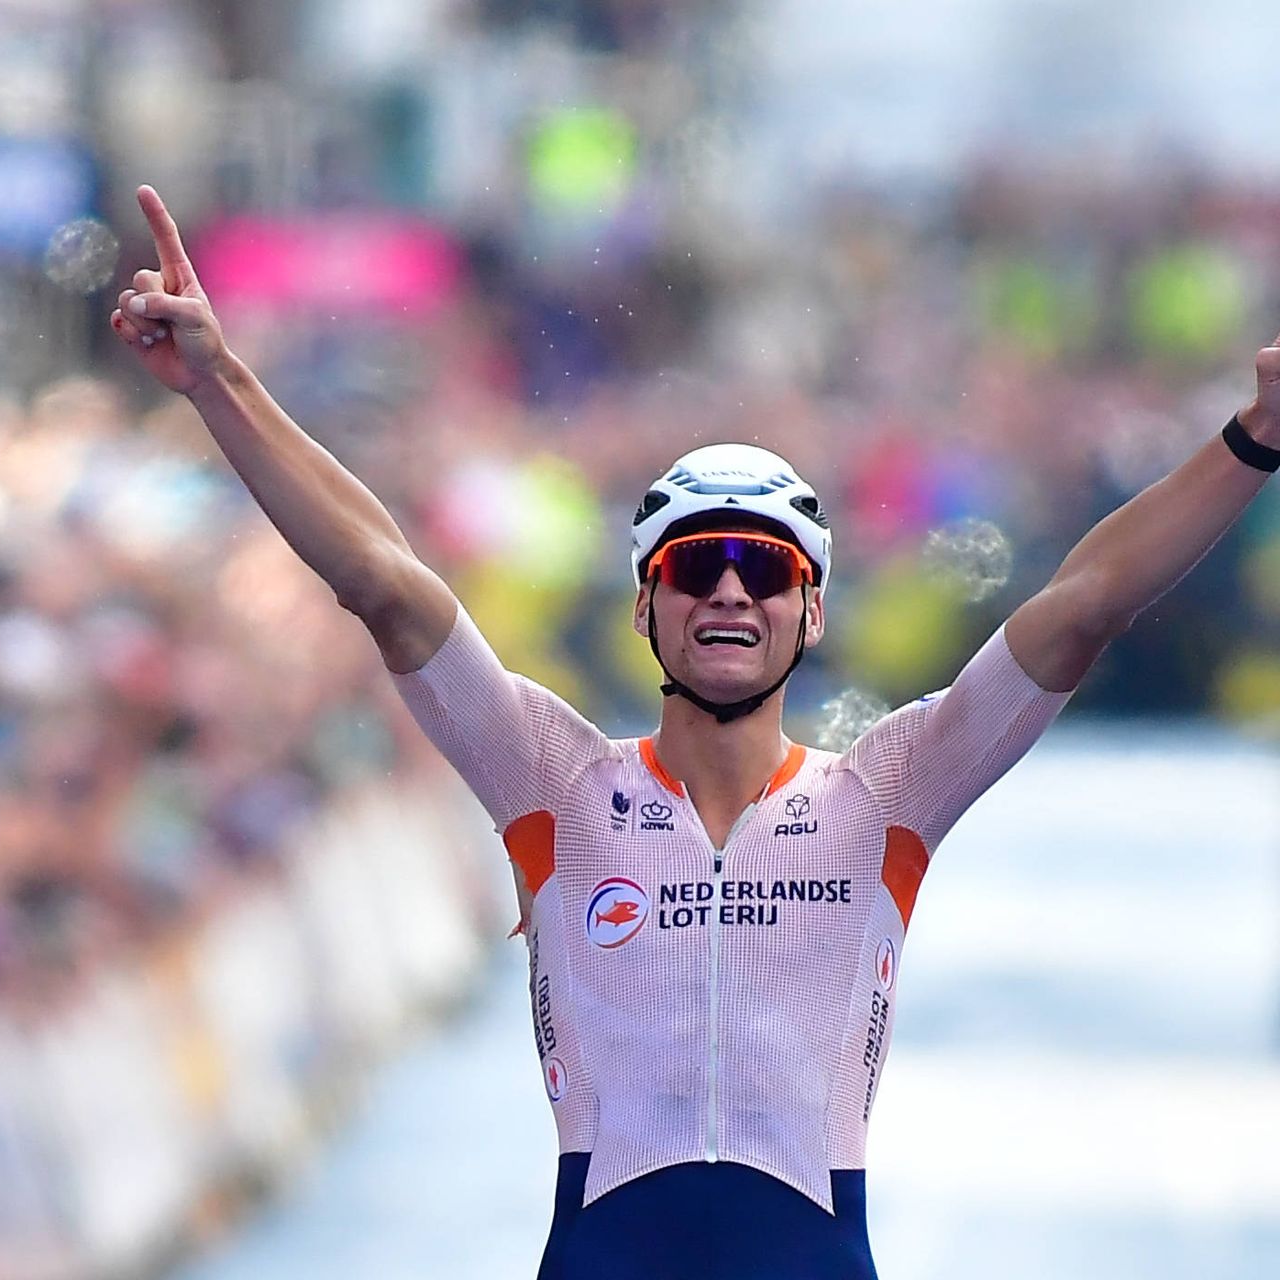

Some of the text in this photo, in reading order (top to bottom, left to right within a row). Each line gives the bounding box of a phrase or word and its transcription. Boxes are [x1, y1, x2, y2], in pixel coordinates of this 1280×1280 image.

[774, 819, 818, 837] AGU
[659, 878, 852, 904] NEDERLANDSE
[658, 904, 779, 930] LOTERIJ
